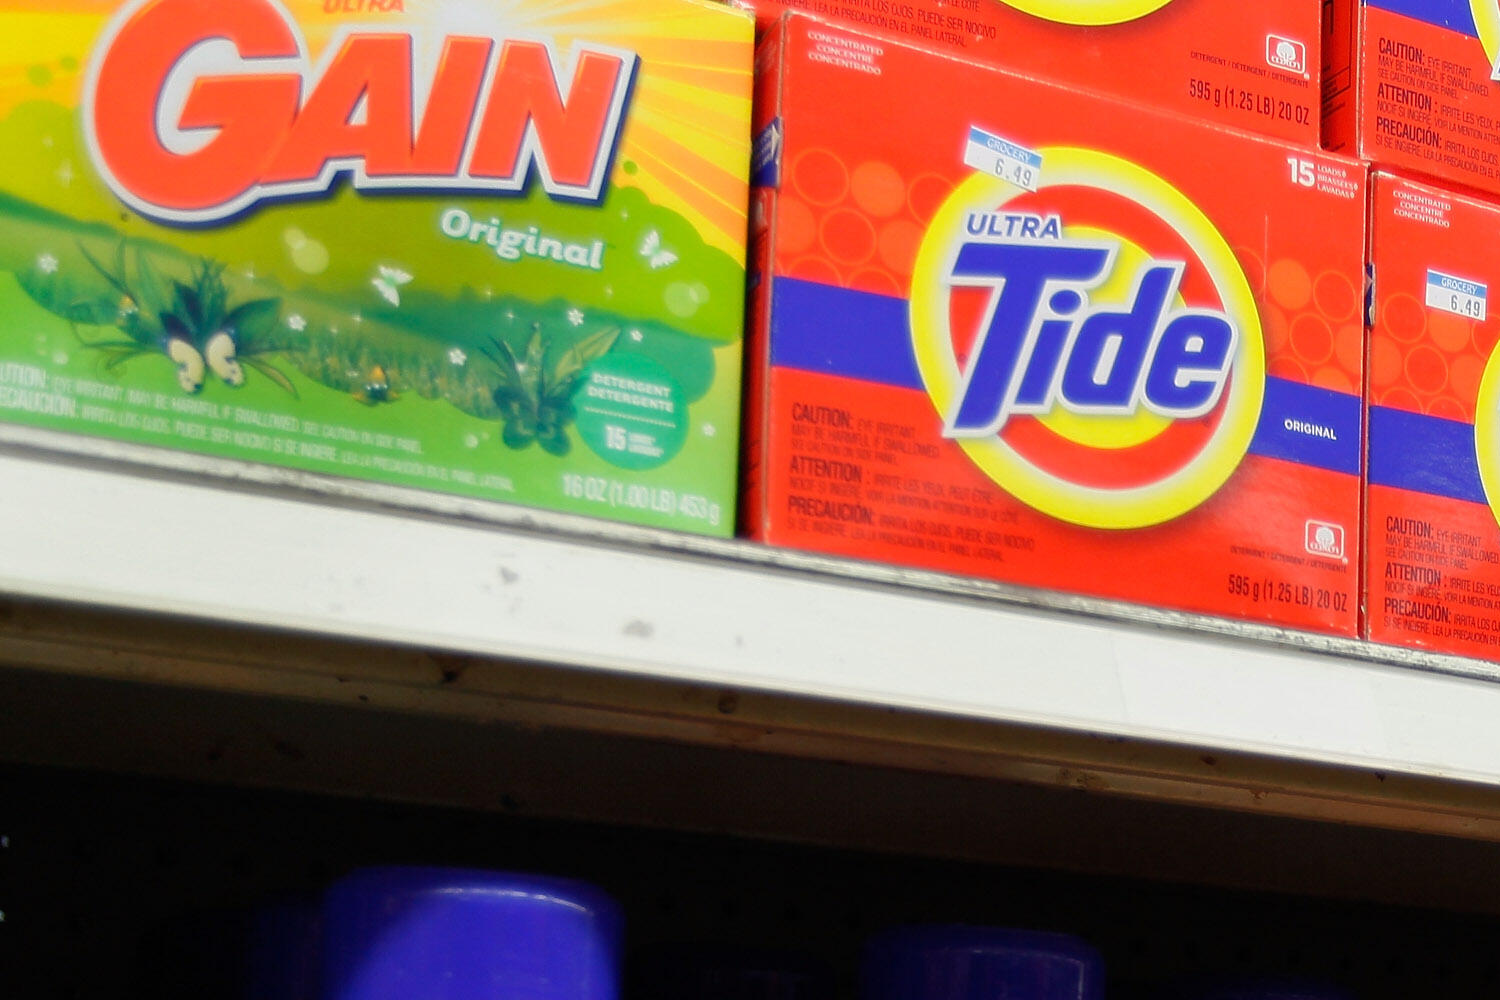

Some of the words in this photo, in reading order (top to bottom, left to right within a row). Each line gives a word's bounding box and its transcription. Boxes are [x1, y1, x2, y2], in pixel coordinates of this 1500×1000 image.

[807, 31, 884, 55] CONCENTRATED
[1379, 37, 1425, 65] CAUTION:
[808, 52, 882, 76] CONCENTRADO
[1190, 78, 1211, 100] 595
[1214, 88, 1221, 107] g
[1224, 84, 1253, 111] (1.25
[1256, 94, 1275, 120] LB)
[1279, 101, 1291, 121] 20
[1295, 106, 1310, 125] OZ
[1377, 83, 1432, 111] ATTENTION
[90, 0, 630, 222] GAIN
[1377, 116, 1441, 149] PRECAUCIÓN:
[987, 138, 1031, 162] GROCERY
[995, 158, 1032, 186] 6.49
[1287, 157, 1315, 187] 15
[1393, 189, 1451, 210] CONCENTRATED
[966, 213, 1060, 240] ULTRA
[1393, 208, 1450, 228] CONCENTRADO
[441, 208, 604, 269] Original
[1441, 277, 1477, 295] GROCERY
[1451, 295, 1480, 317] 6.49
[943, 240, 1241, 438] Tide
[592, 372, 671, 398] DETERGENT
[587, 385, 675, 413] DETERGENTE
[792, 402, 853, 430] CAUTION:
[1284, 418, 1337, 440] ORIGINAL
[605, 425, 627, 450] 15
[790, 456, 862, 482] ATTENTION
[563, 474, 584, 498] 16
[586, 478, 608, 502] OZ
[1386, 516, 1434, 539] CAUTION:
[1385, 562, 1441, 587] ATTENTION
[1228, 574, 1249, 596] 595
[1252, 583, 1259, 602] g
[1263, 579, 1291, 602] (1.25
[1295, 586, 1313, 608] LB)
[1317, 590, 1329, 609] 20
[1334, 592, 1348, 612] OZ
[1384, 597, 1451, 624] PRECAUCIÓN:
